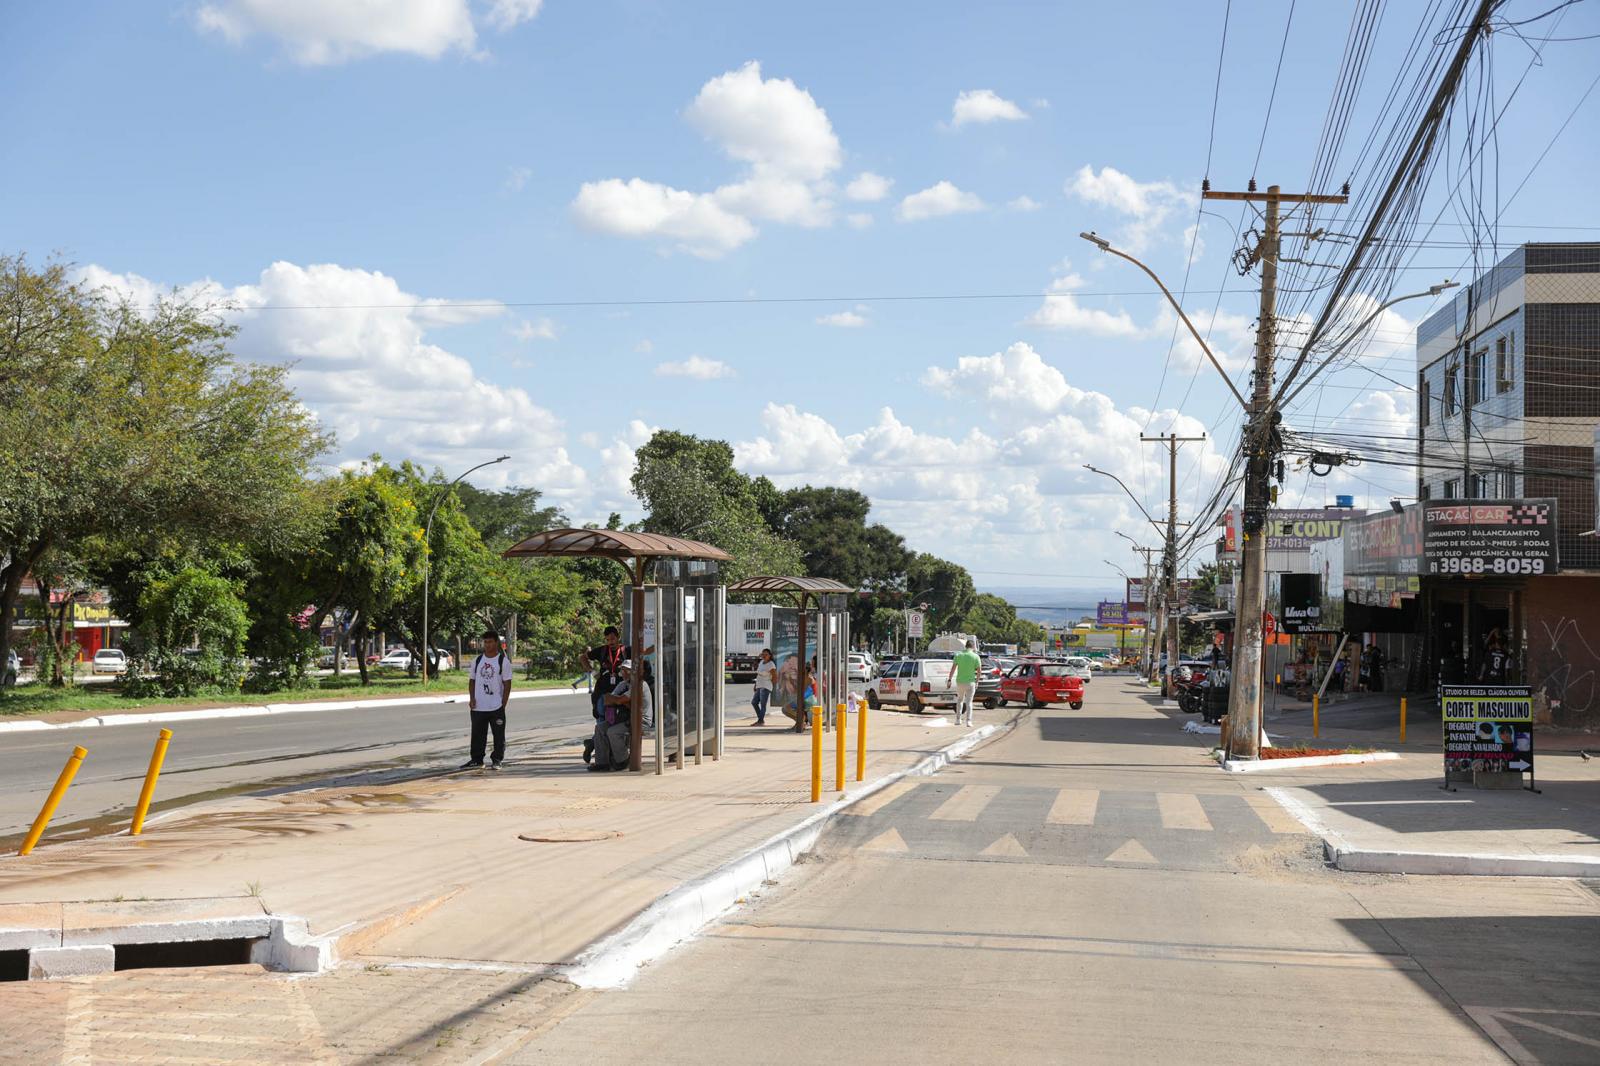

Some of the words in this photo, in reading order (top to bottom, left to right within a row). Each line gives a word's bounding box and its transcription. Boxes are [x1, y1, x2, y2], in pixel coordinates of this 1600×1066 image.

[1475, 509, 1504, 520] CAR
[1264, 520, 1344, 537] DECONT
[1440, 558, 1544, 574] 3968-8059
[1493, 656, 1500, 669] 8
[1446, 701, 1474, 718] CORTE
[1478, 701, 1529, 718] MASCULINO
